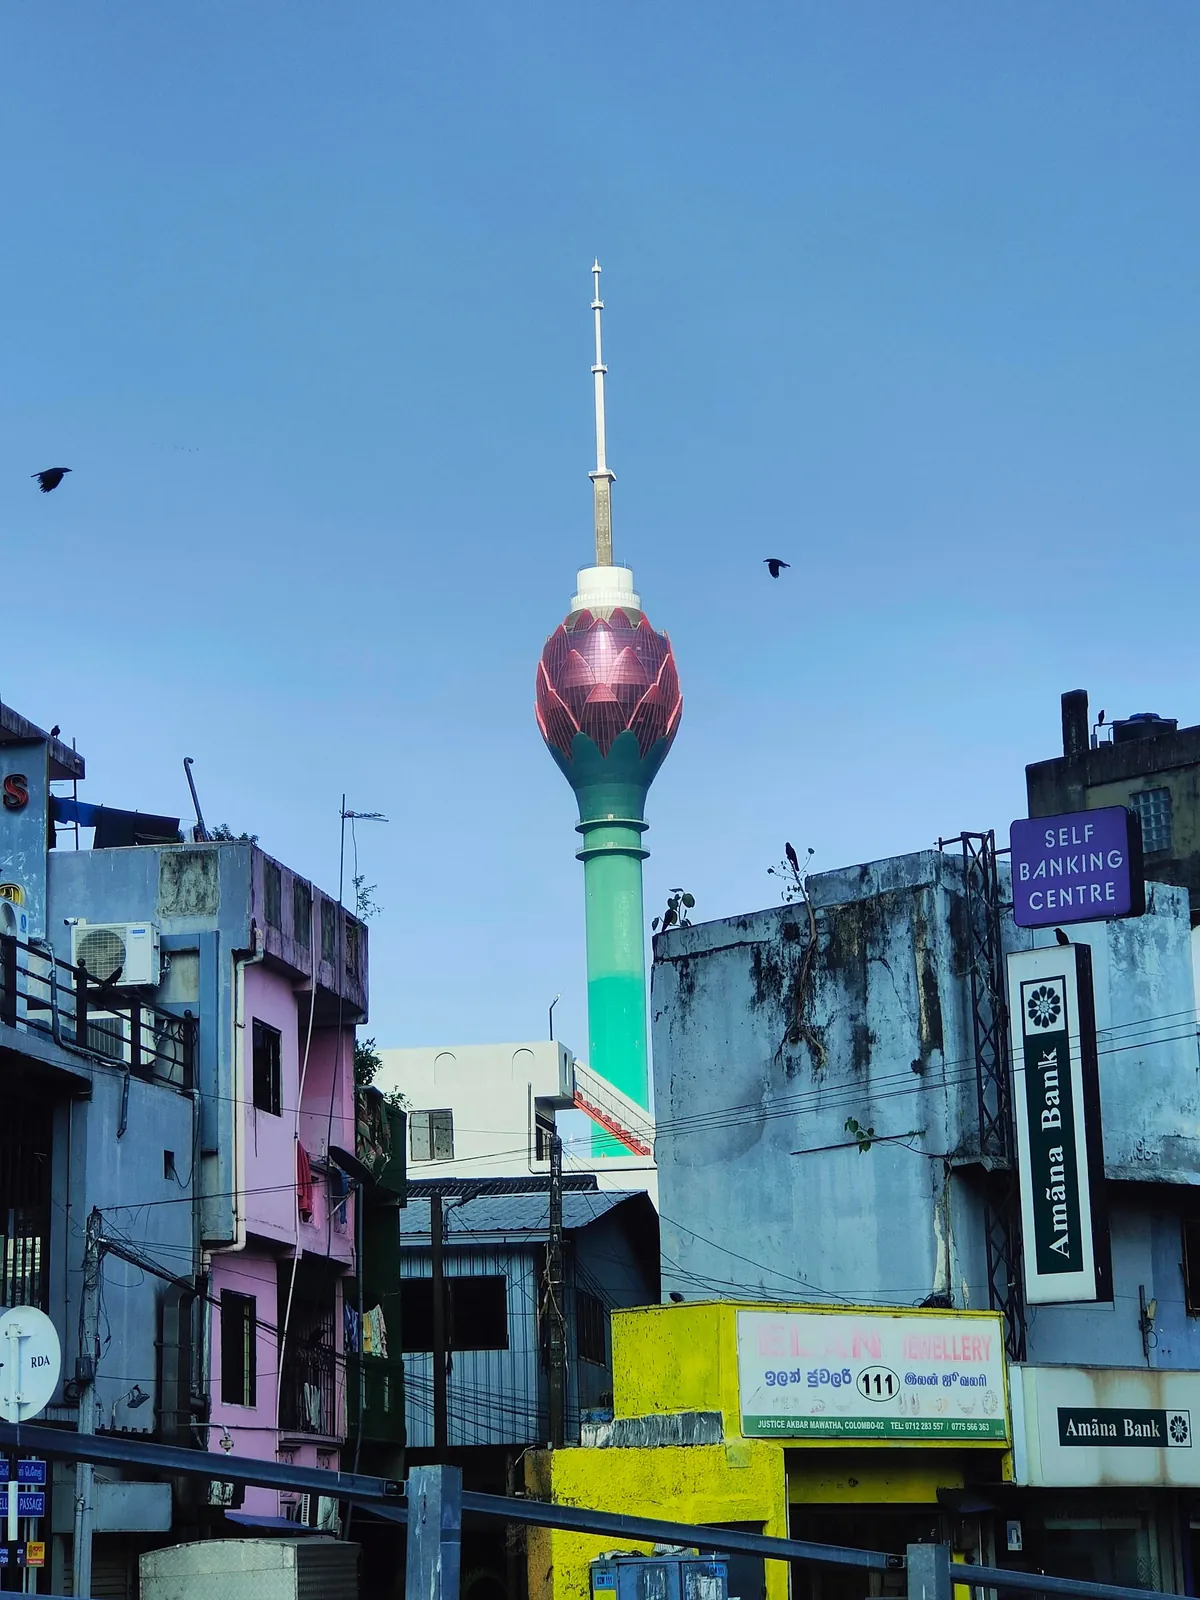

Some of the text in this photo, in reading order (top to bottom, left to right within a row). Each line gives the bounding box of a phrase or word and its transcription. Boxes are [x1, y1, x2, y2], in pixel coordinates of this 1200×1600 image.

[1045, 824, 1094, 848] SELF
[1019, 849, 1123, 881] BANKING
[1029, 881, 1115, 910] CENTRE
[1038, 1047, 1070, 1259] Amãna Bank
[31, 1355, 51, 1369] RDA
[862, 1374, 893, 1395] 111
[757, 1420, 885, 1431] JUSTICE AKBAR MAWATHA, COLOMBO-02
[890, 1421, 905, 1431] TEL:
[905, 1422, 920, 1431] 0712
[933, 1422, 944, 1431] 557
[951, 1422, 966, 1432] 0775
[1066, 1418, 1161, 1437] Amãna Bank
[20, 1498, 42, 1511] PASSAGE
